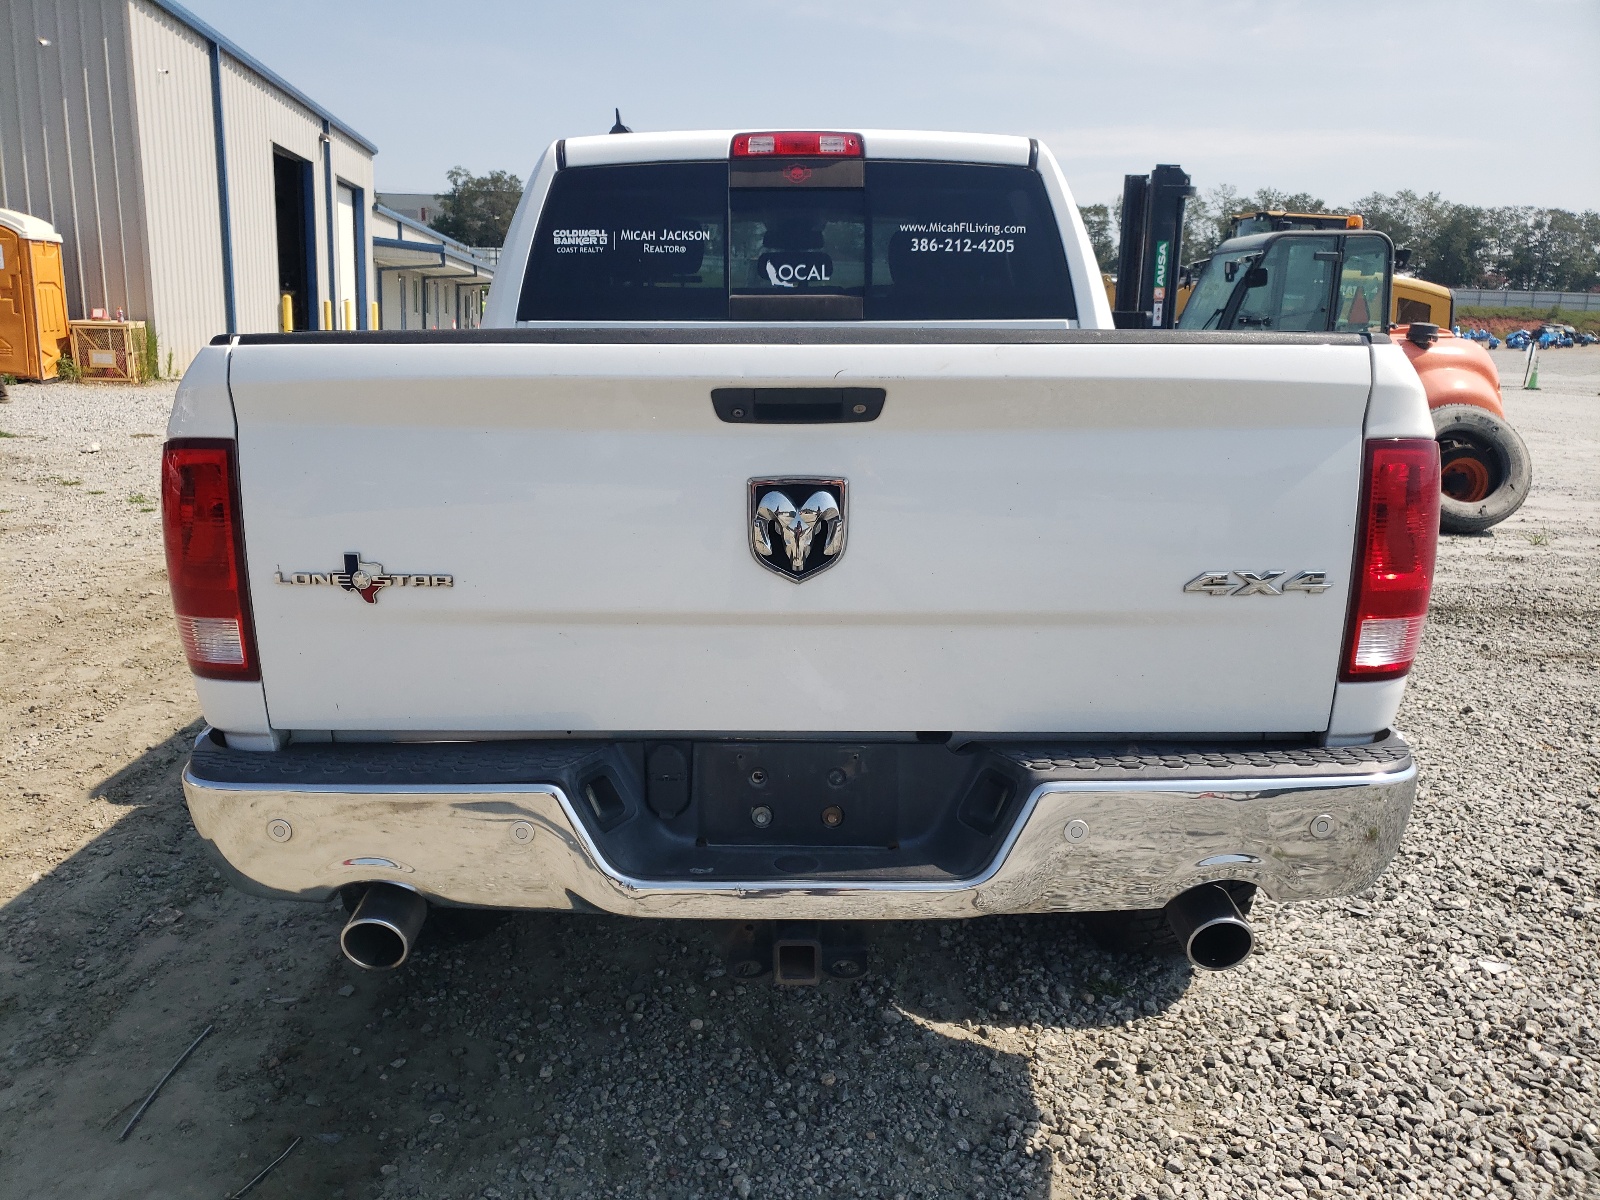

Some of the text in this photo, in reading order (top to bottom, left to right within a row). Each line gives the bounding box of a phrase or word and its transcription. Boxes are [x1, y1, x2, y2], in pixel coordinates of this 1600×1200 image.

[553, 229, 608, 237] COLDWELL
[620, 229, 710, 241] MICAH JACKSON
[553, 237, 598, 246] BANKER
[910, 238, 1015, 253] 386-212-4205
[556, 246, 604, 254] COAST REALTY
[1156, 243, 1167, 287] AUSA
[272, 570, 454, 588] LONE STAR
[1183, 570, 1335, 596] 4X4
